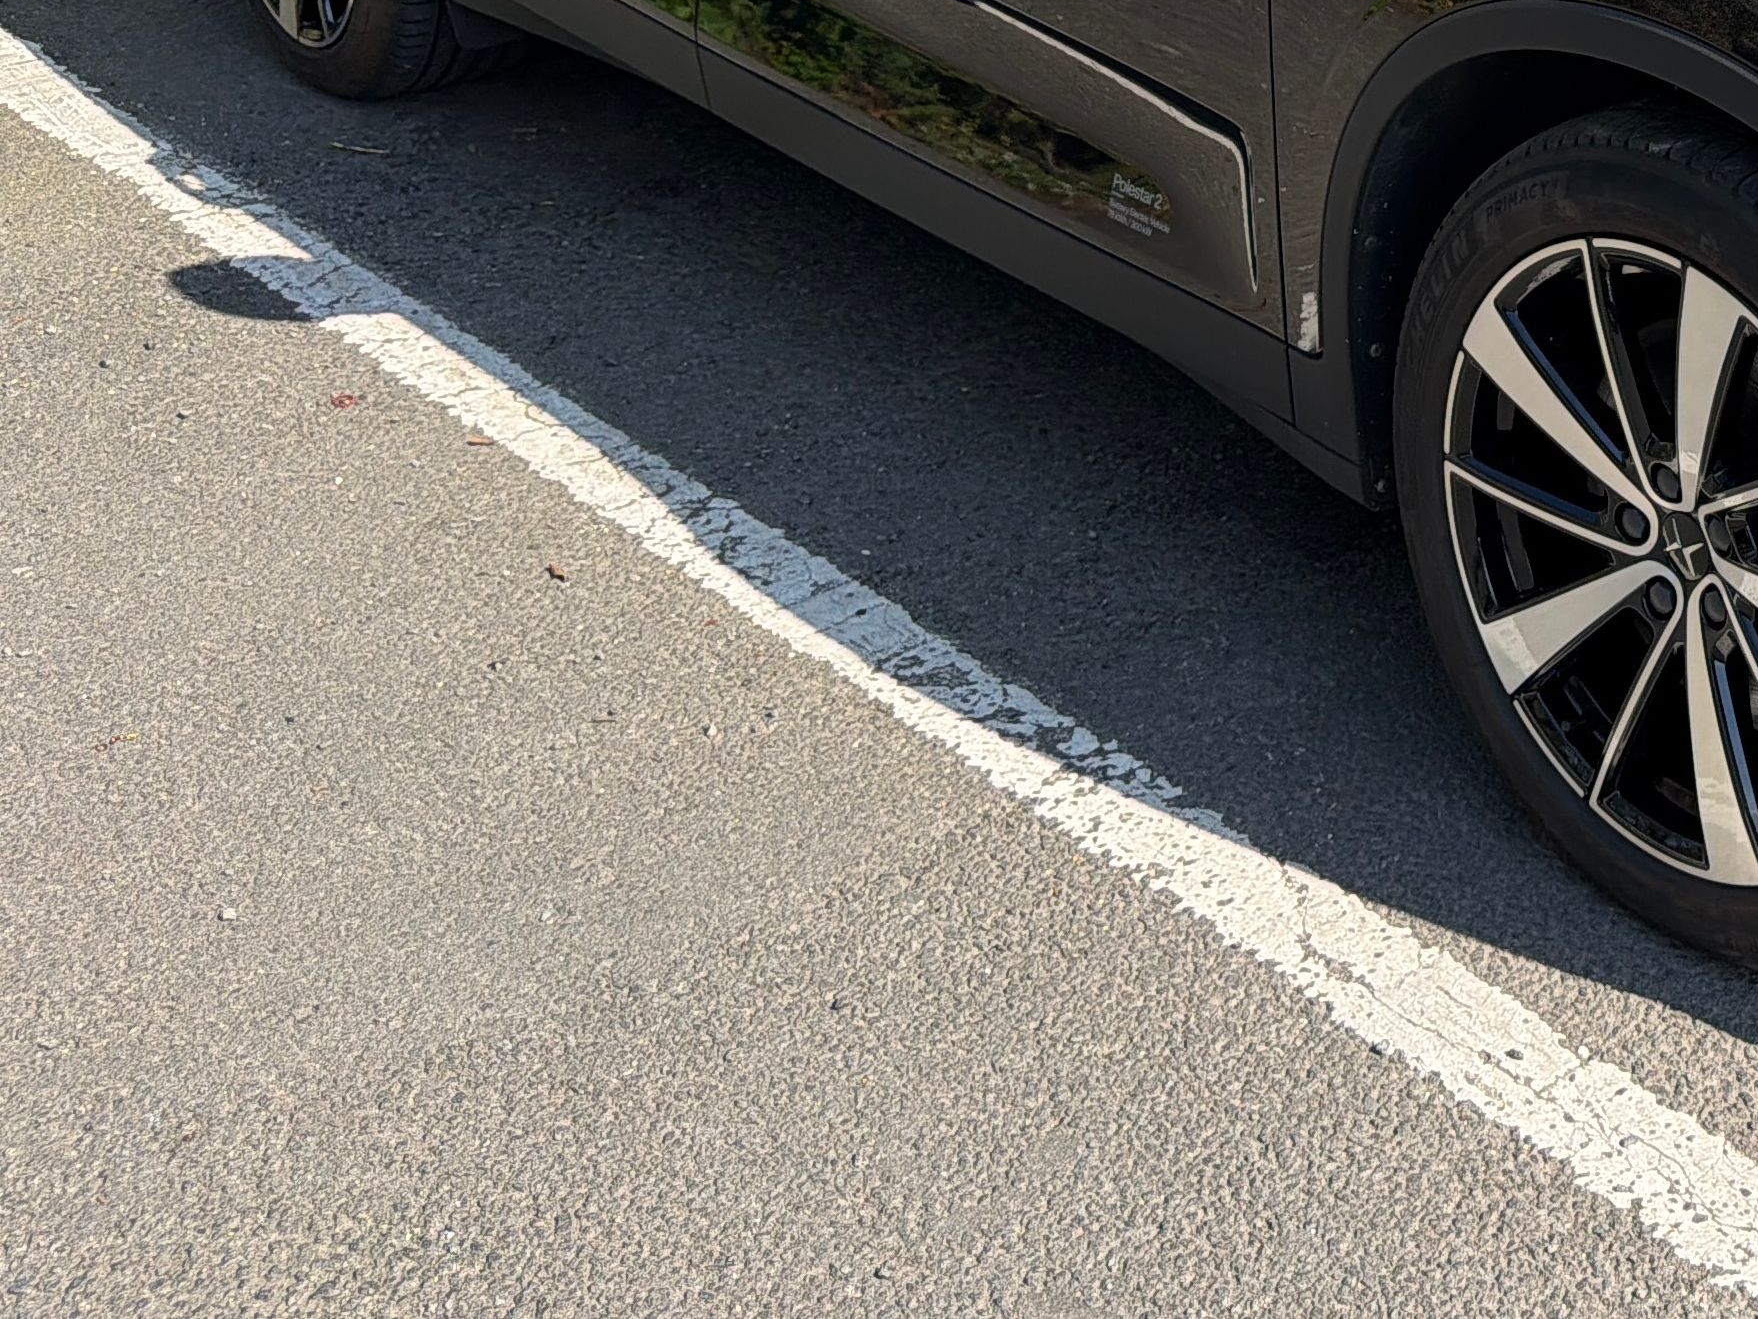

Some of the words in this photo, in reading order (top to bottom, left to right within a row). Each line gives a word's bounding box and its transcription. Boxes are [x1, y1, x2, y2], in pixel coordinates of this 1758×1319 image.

[1112, 172, 1154, 207] Polestar
[1153, 193, 1163, 210] 2
[1486, 180, 1549, 222] PRIMACY
